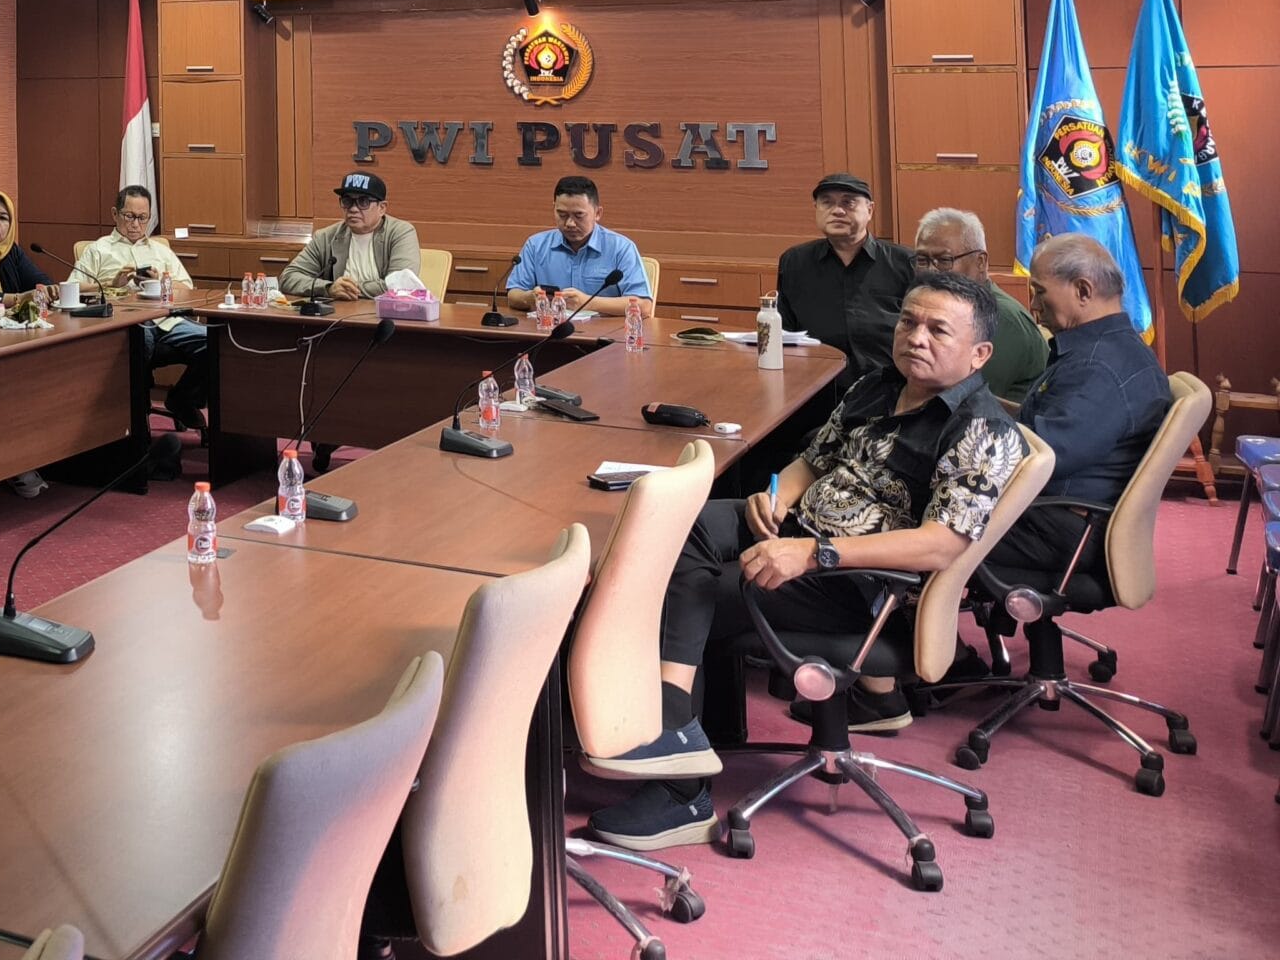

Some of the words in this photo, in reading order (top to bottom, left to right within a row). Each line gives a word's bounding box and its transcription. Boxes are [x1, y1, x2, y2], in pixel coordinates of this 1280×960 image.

[1054, 121, 1106, 140] PERSATUAN
[351, 120, 494, 166] PWI
[516, 121, 777, 171] PUSAT
[344, 174, 370, 190] PWI
[1041, 156, 1075, 195] INDONESIA
